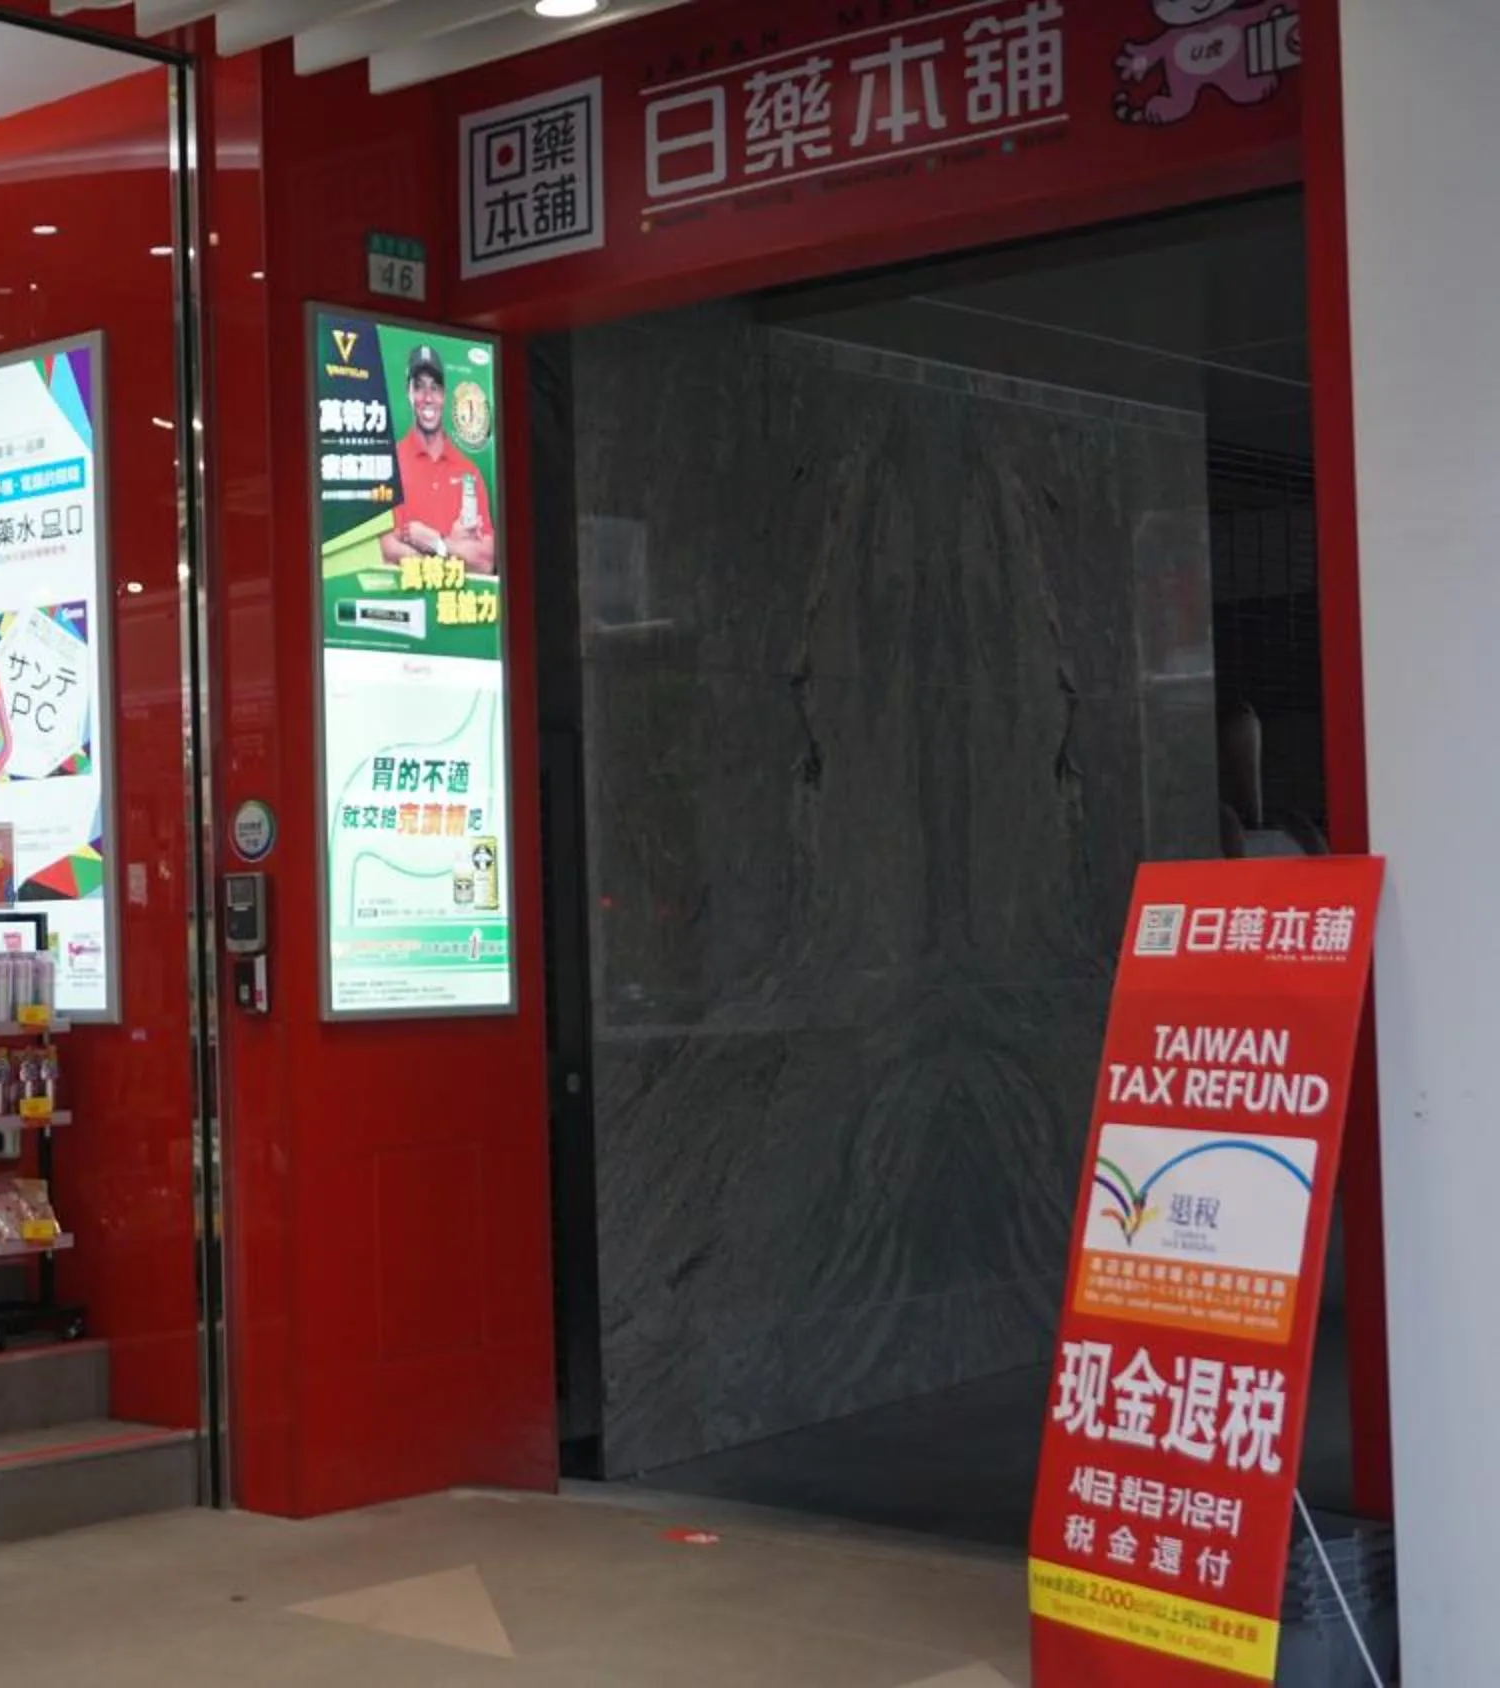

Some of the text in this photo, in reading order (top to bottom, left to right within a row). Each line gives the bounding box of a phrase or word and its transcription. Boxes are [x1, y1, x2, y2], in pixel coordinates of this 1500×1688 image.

[645, 1, 1064, 197] 日藥本舖
[484, 174, 577, 246] 本舖
[380, 261, 415, 292] 46
[8, 651, 77, 697] サンテ
[10, 691, 58, 733] PC
[372, 756, 471, 794] 胃的不適
[1185, 906, 1356, 953] 日藥本舖
[1155, 1024, 1290, 1067] TAIWAN
[1108, 1063, 1330, 1115] TAX REFUND
[1052, 1339, 1286, 1474] 现金退税
[1068, 1465, 1117, 1508] 세금
[1167, 1486, 1243, 1538] 카운터
